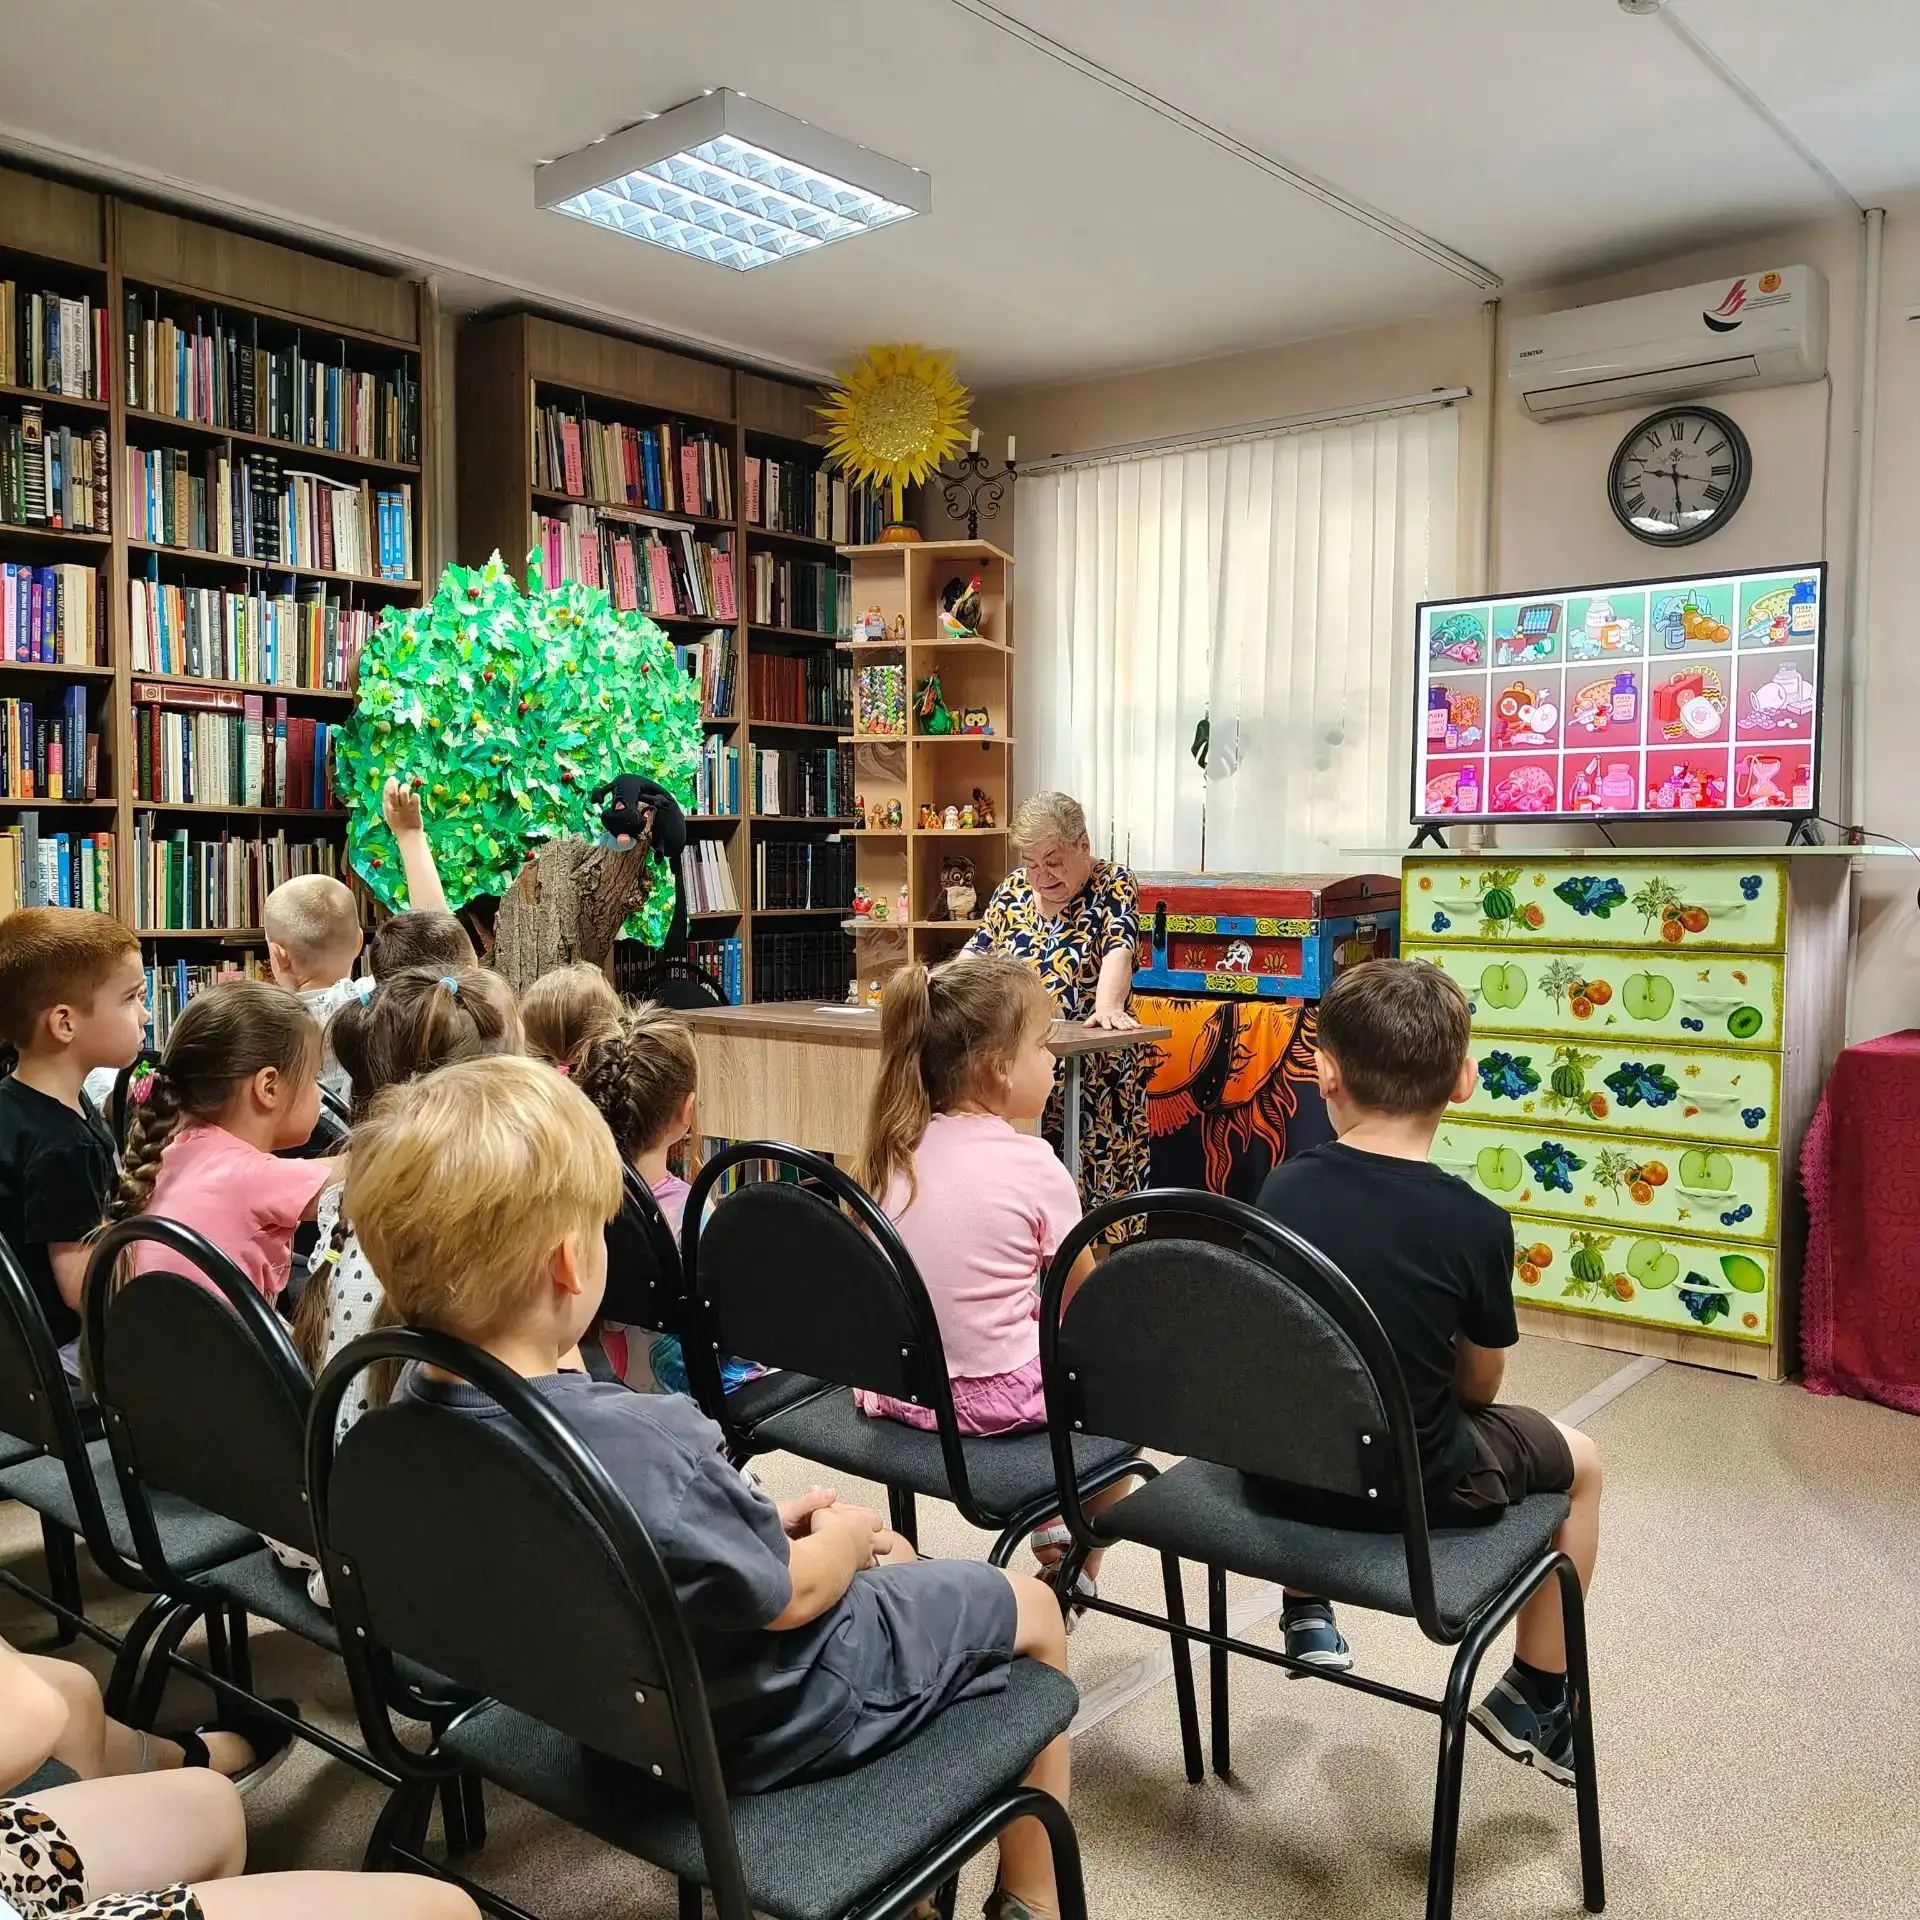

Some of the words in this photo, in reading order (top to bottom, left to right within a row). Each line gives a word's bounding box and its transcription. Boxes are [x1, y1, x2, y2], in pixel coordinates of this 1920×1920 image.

[1519, 348, 1544, 359] CENTEK
[1669, 419, 1685, 442] XII
[1693, 422, 1707, 445] I
[1646, 430, 1663, 453] XI
[1705, 440, 1726, 457] II
[1711, 464, 1731, 477] III
[39, 862, 47, 878] МИР
[50, 862, 58, 878] МИР
